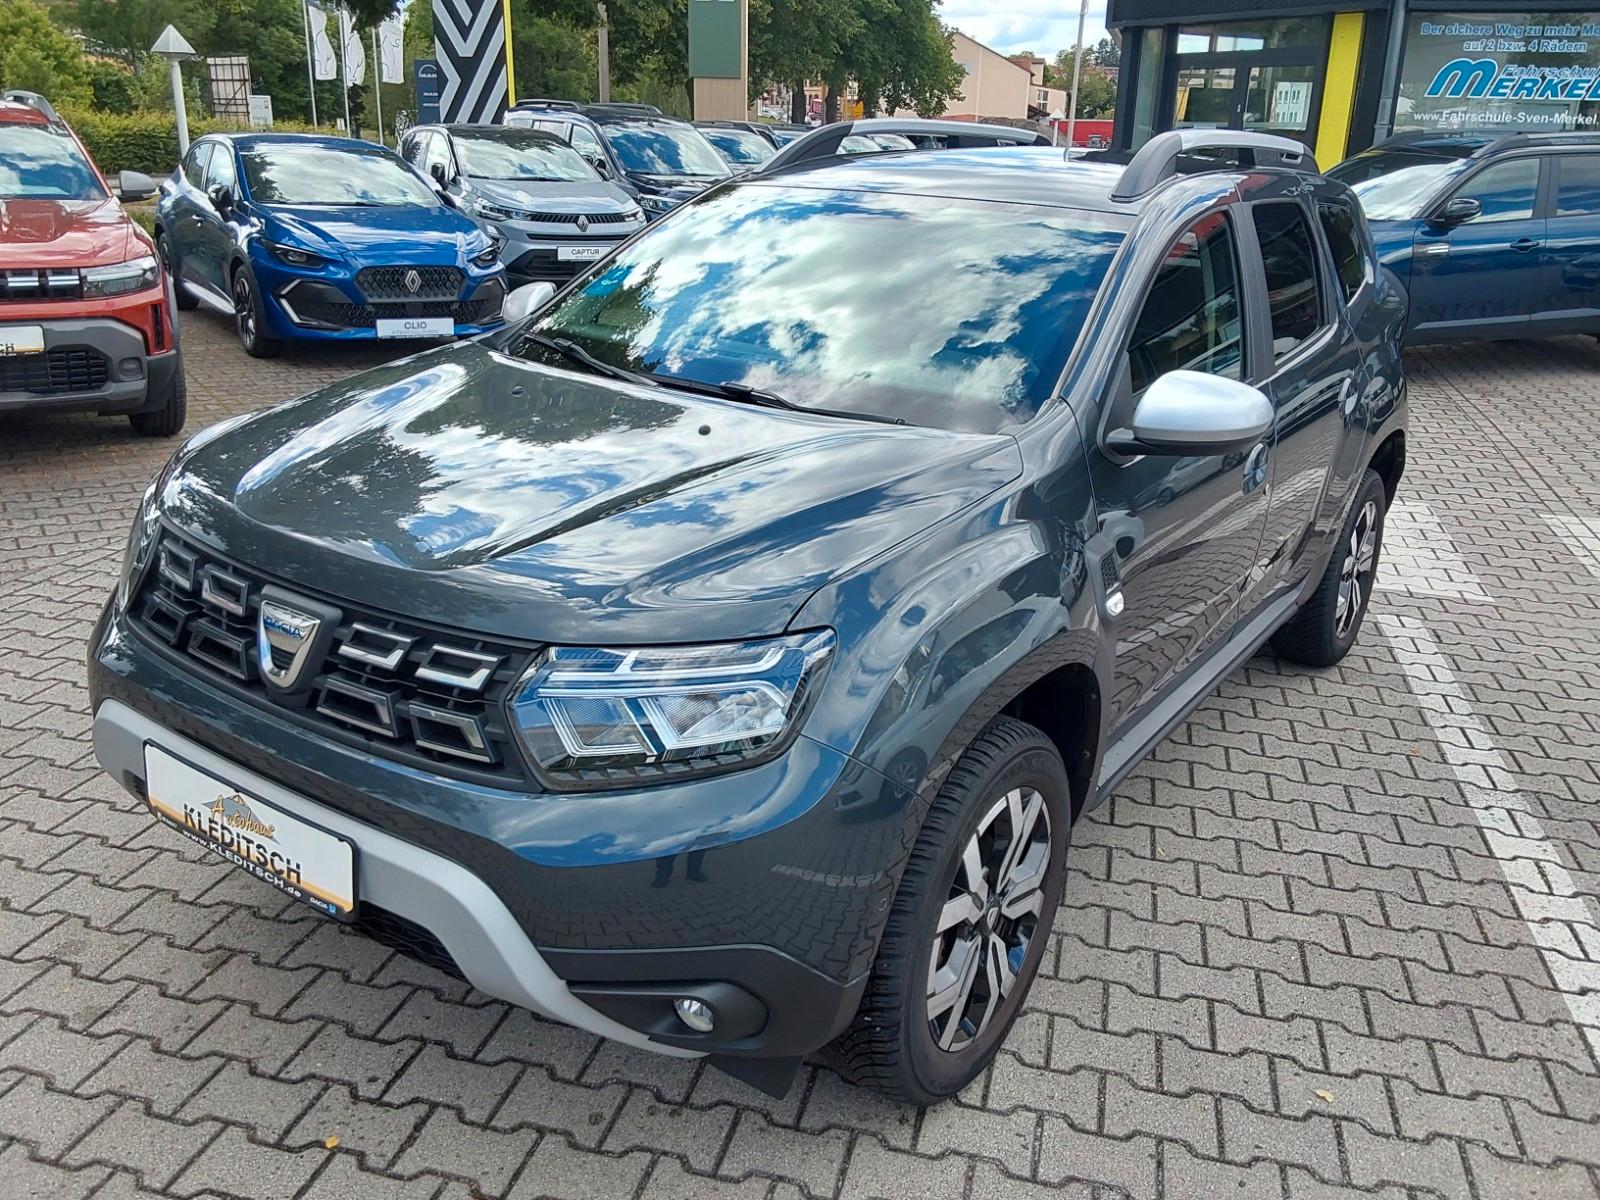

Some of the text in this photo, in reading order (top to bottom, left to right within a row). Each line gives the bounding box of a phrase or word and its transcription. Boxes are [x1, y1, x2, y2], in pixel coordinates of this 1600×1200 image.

[1421, 23, 1444, 35] Der
[1445, 23, 1492, 36] sichere
[1495, 24, 1523, 38] Weg
[1526, 26, 1541, 36] zu
[1544, 24, 1580, 37] mehr
[1464, 39, 1588, 53] auf 2 bzw. 4 Rädern
[404, 321, 427, 329] CLIO
[183, 803, 302, 885] KLEDITSCH
